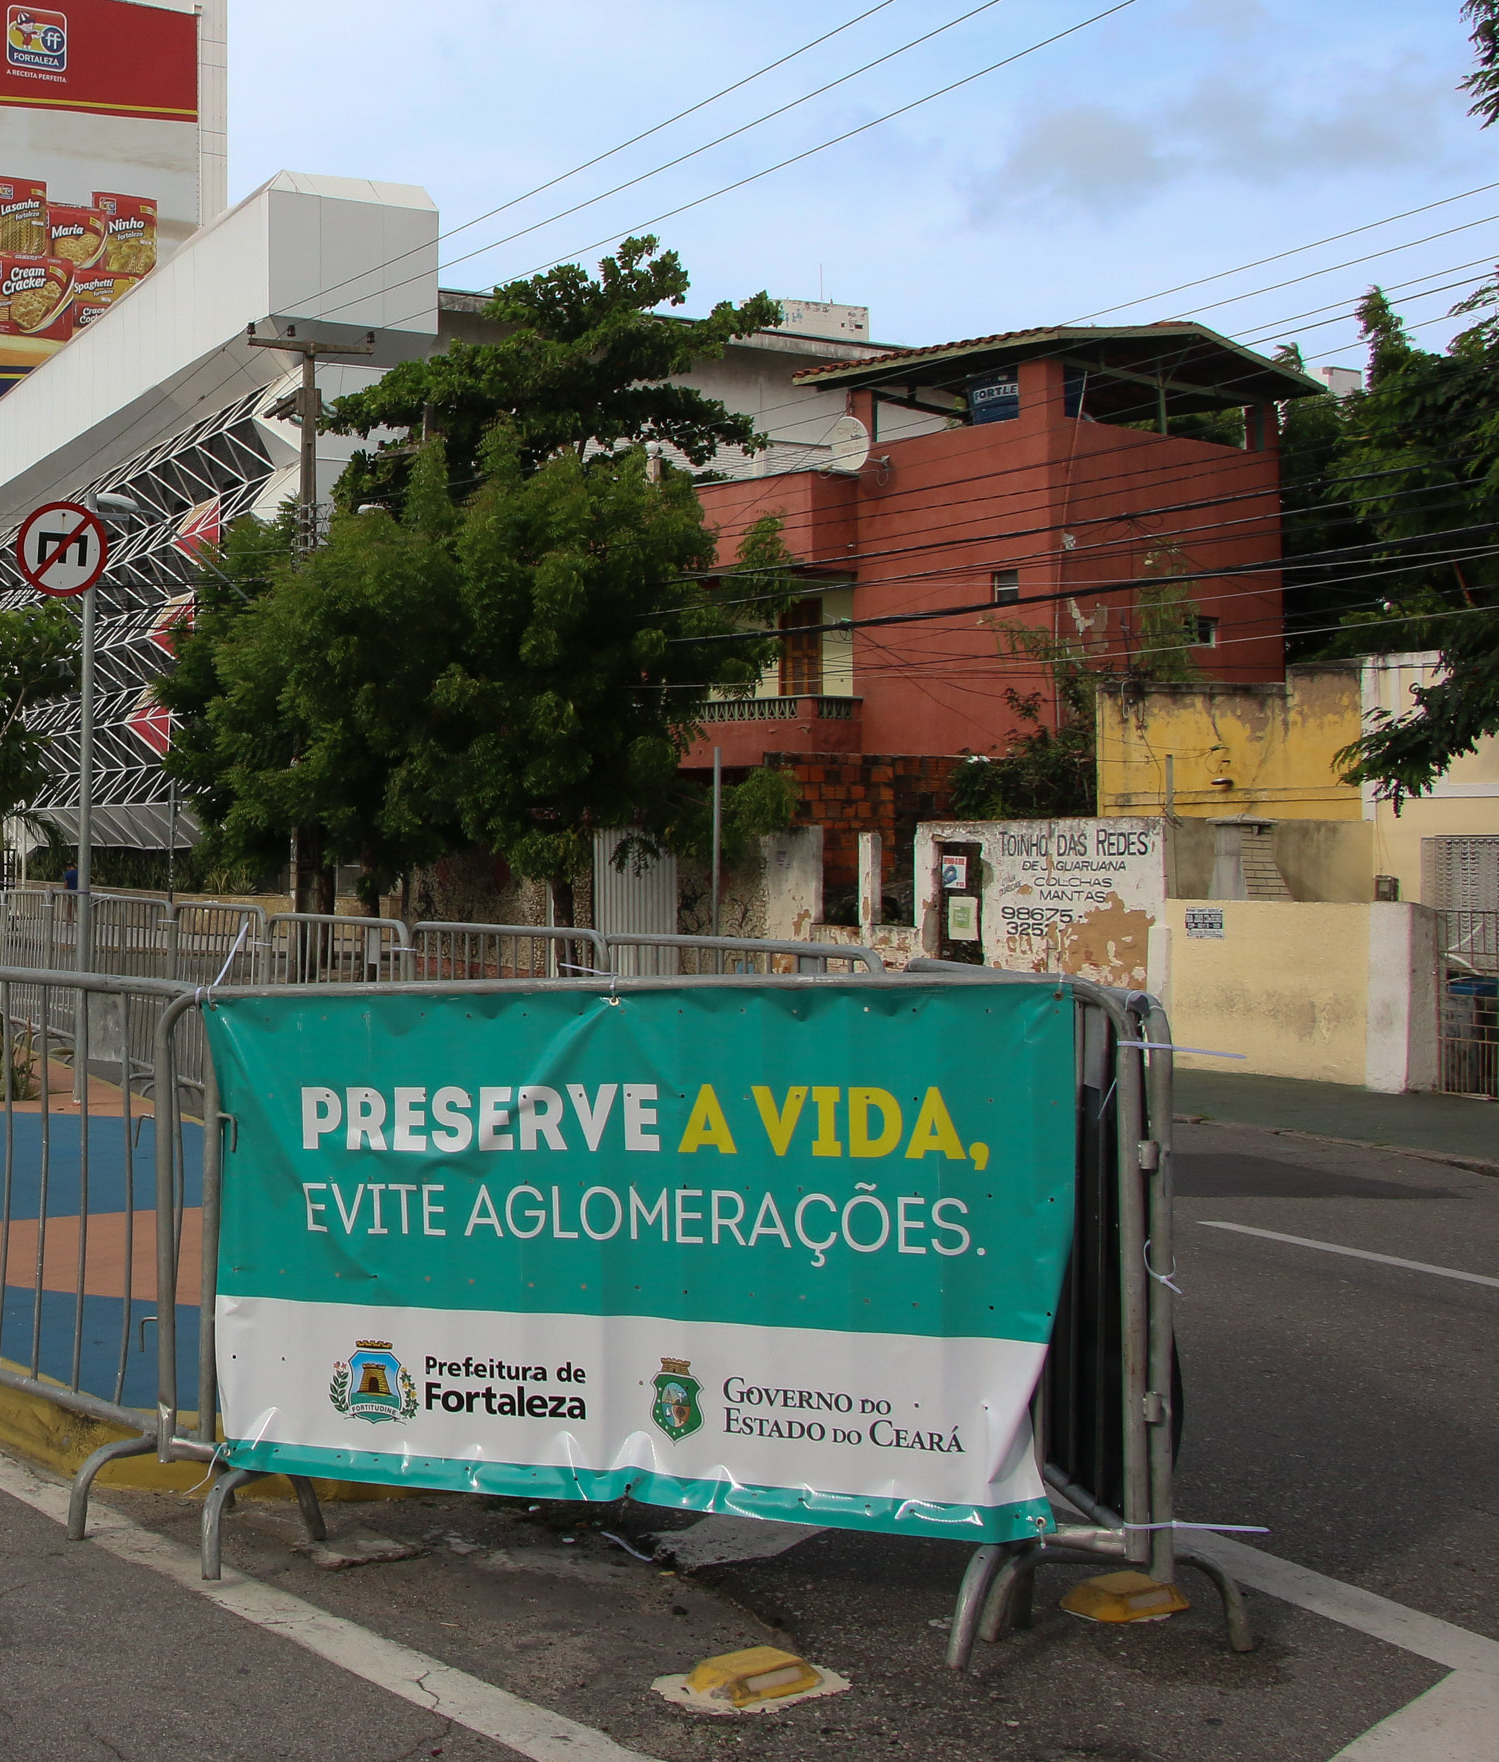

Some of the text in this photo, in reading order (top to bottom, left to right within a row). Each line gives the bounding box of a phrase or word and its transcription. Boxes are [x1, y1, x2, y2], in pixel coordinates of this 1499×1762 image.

[13, 52, 60, 67] FORTALEZA
[12, 69, 38, 79] RECEITA
[38, 73, 67, 83] PERFEITA
[0, 198, 40, 216] Lasanha
[15, 210, 40, 221] Fortaleza
[51, 224, 84, 239] Maria
[108, 217, 145, 233] Ninho
[117, 231, 143, 241] Fortaleza
[10, 265, 45, 281] Cream
[2, 278, 47, 295] Cracker
[74, 278, 114, 293] Spaghetti
[1057, 833, 1088, 857] DAS
[1096, 829, 1149, 856] REDES
[1022, 860, 1040, 871] DE
[1033, 877, 1113, 887] COLCHAS
[1039, 890, 1107, 903] MANTAS
[300, 1083, 990, 1171] PRESERVE A VIDA,
[302, 1182, 987, 1268] EVITE AGLOMERAÇÕES.
[425, 1355, 586, 1384] Prefeitura de
[425, 1381, 587, 1420] Fortaleza
[722, 1376, 892, 1415] GOVERNO DO
[351, 1404, 397, 1417] FORTITUDINE
[722, 1406, 966, 1453] ESTADO DO CEARÁ
